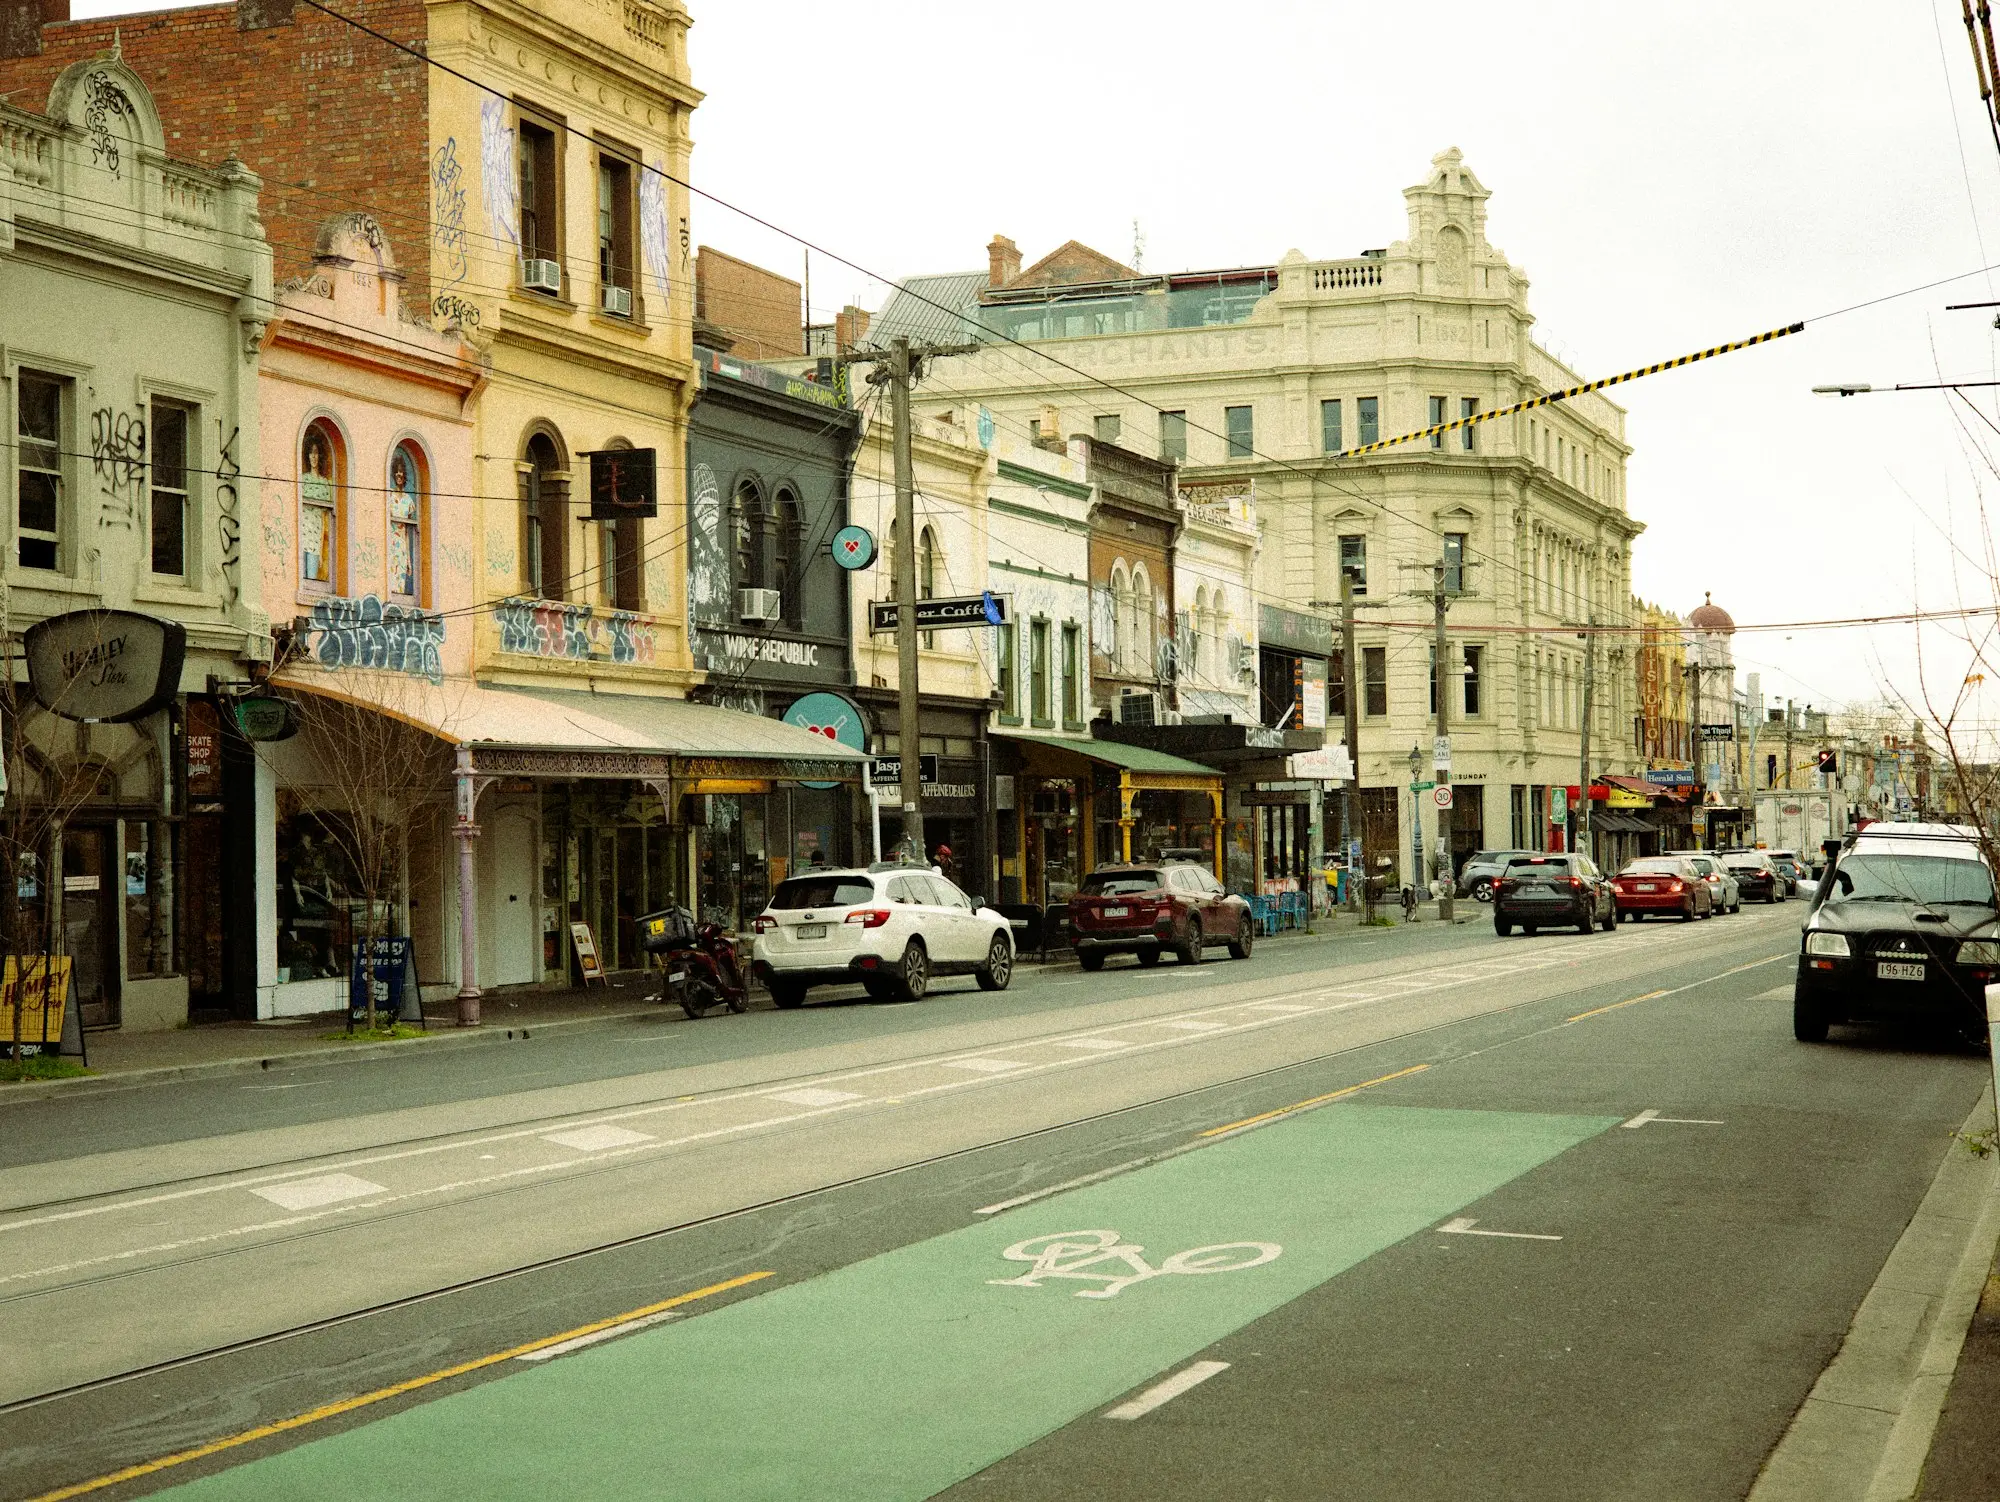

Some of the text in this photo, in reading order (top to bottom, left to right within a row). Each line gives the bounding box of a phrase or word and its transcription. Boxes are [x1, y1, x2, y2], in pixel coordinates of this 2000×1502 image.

[881, 608, 935, 624] Jaer
[723, 633, 819, 667] WINE REPUBLIC
[187, 735, 212, 747] SKATE
[188, 747, 210, 759] SHOP
[1648, 774, 1692, 783] Herald Sun
[1437, 792, 1449, 801] 30
[653, 923, 661, 932] L
